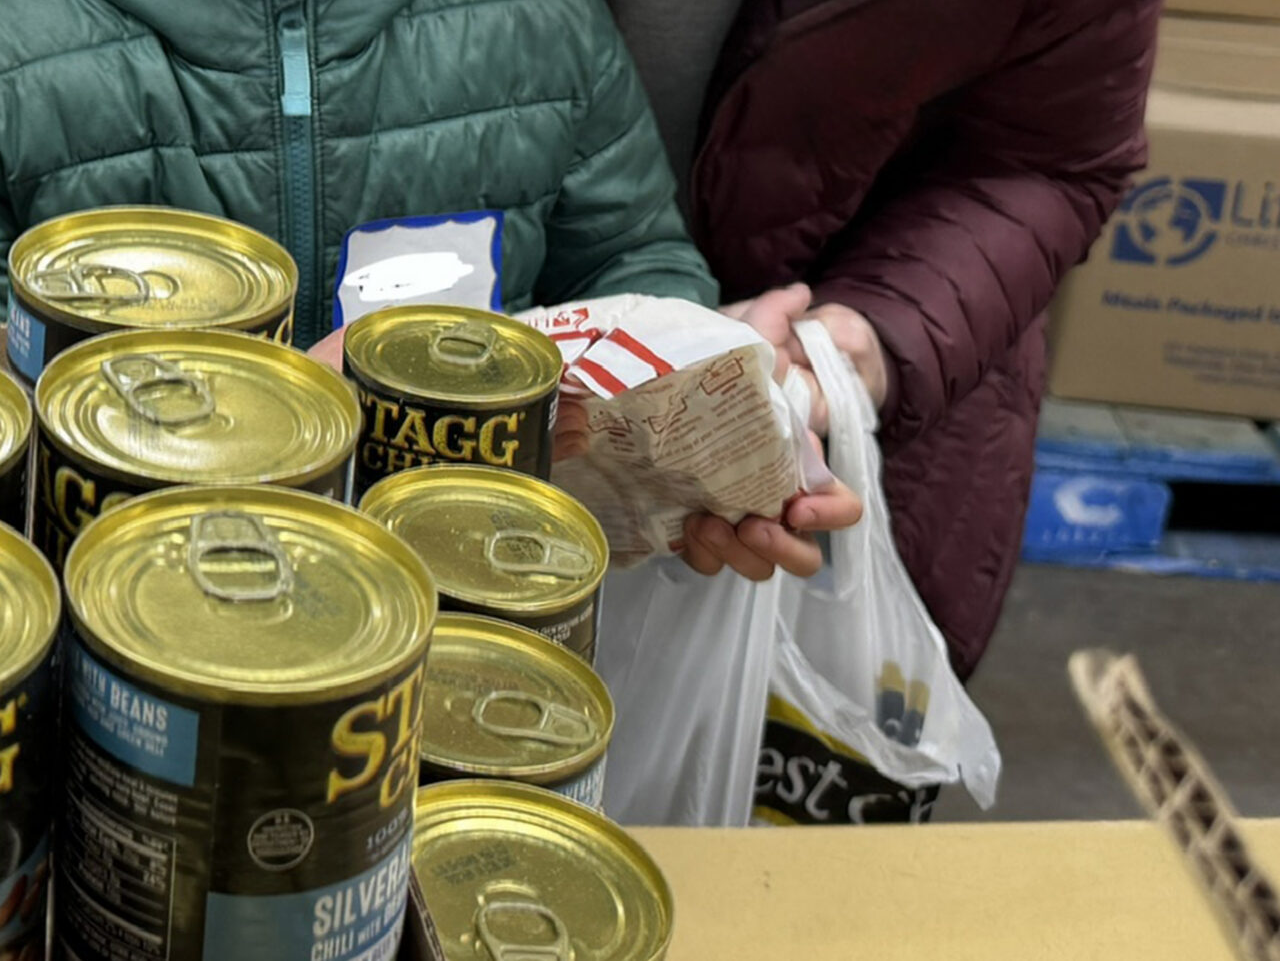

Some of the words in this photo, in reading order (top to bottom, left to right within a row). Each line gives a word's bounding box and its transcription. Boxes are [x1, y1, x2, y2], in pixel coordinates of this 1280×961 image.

[359, 389, 522, 467] TAGG
[109, 680, 169, 732] BEANS
[754, 745, 849, 822] est
